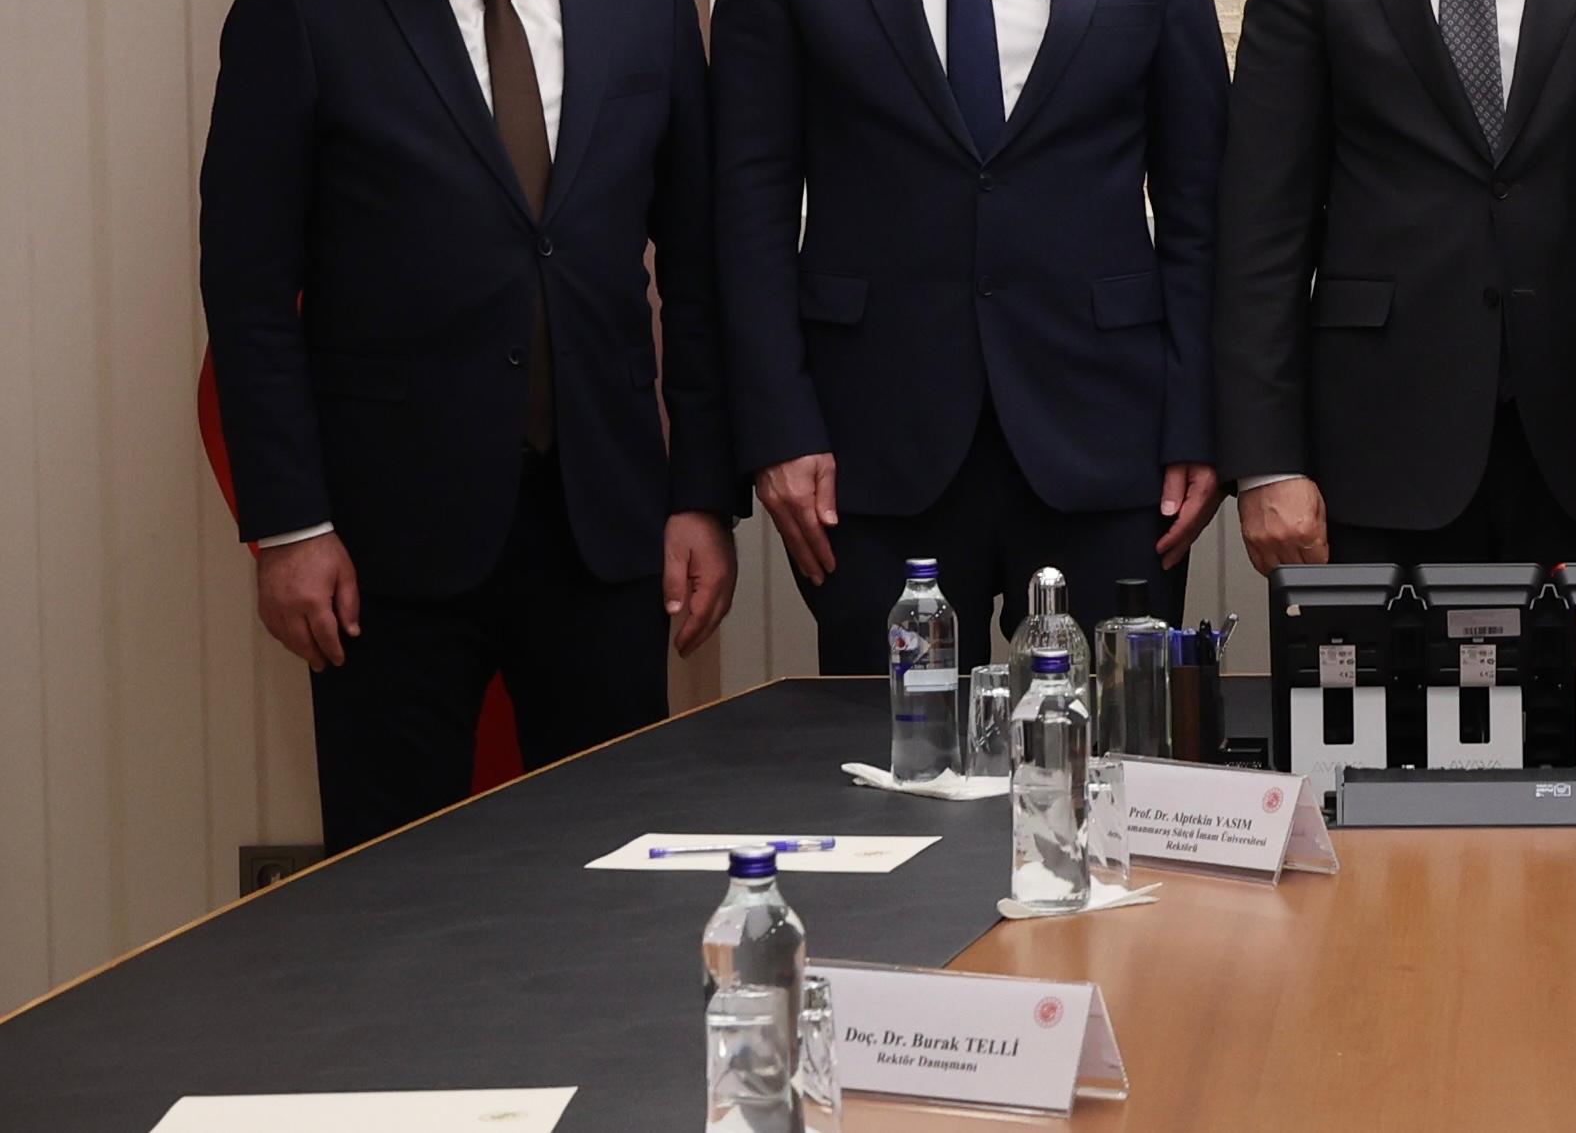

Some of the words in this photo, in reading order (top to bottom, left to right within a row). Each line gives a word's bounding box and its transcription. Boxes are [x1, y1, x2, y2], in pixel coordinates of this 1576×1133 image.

[1129, 806, 1151, 819] Prof.
[1154, 809, 1169, 822] Dr.
[1172, 812, 1213, 827] Alptekin
[1216, 816, 1253, 831] YASIM
[1166, 841, 1198, 853] Rektörü
[1221, 831, 1267, 847] Üniversitesi
[845, 1026, 877, 1047] Doç.
[882, 1030, 906, 1049] Dr.
[912, 1032, 960, 1053] Burak
[964, 1036, 1020, 1058] TELLİ
[876, 1051, 915, 1067] Rektör
[918, 1056, 978, 1073] Danışmanı
